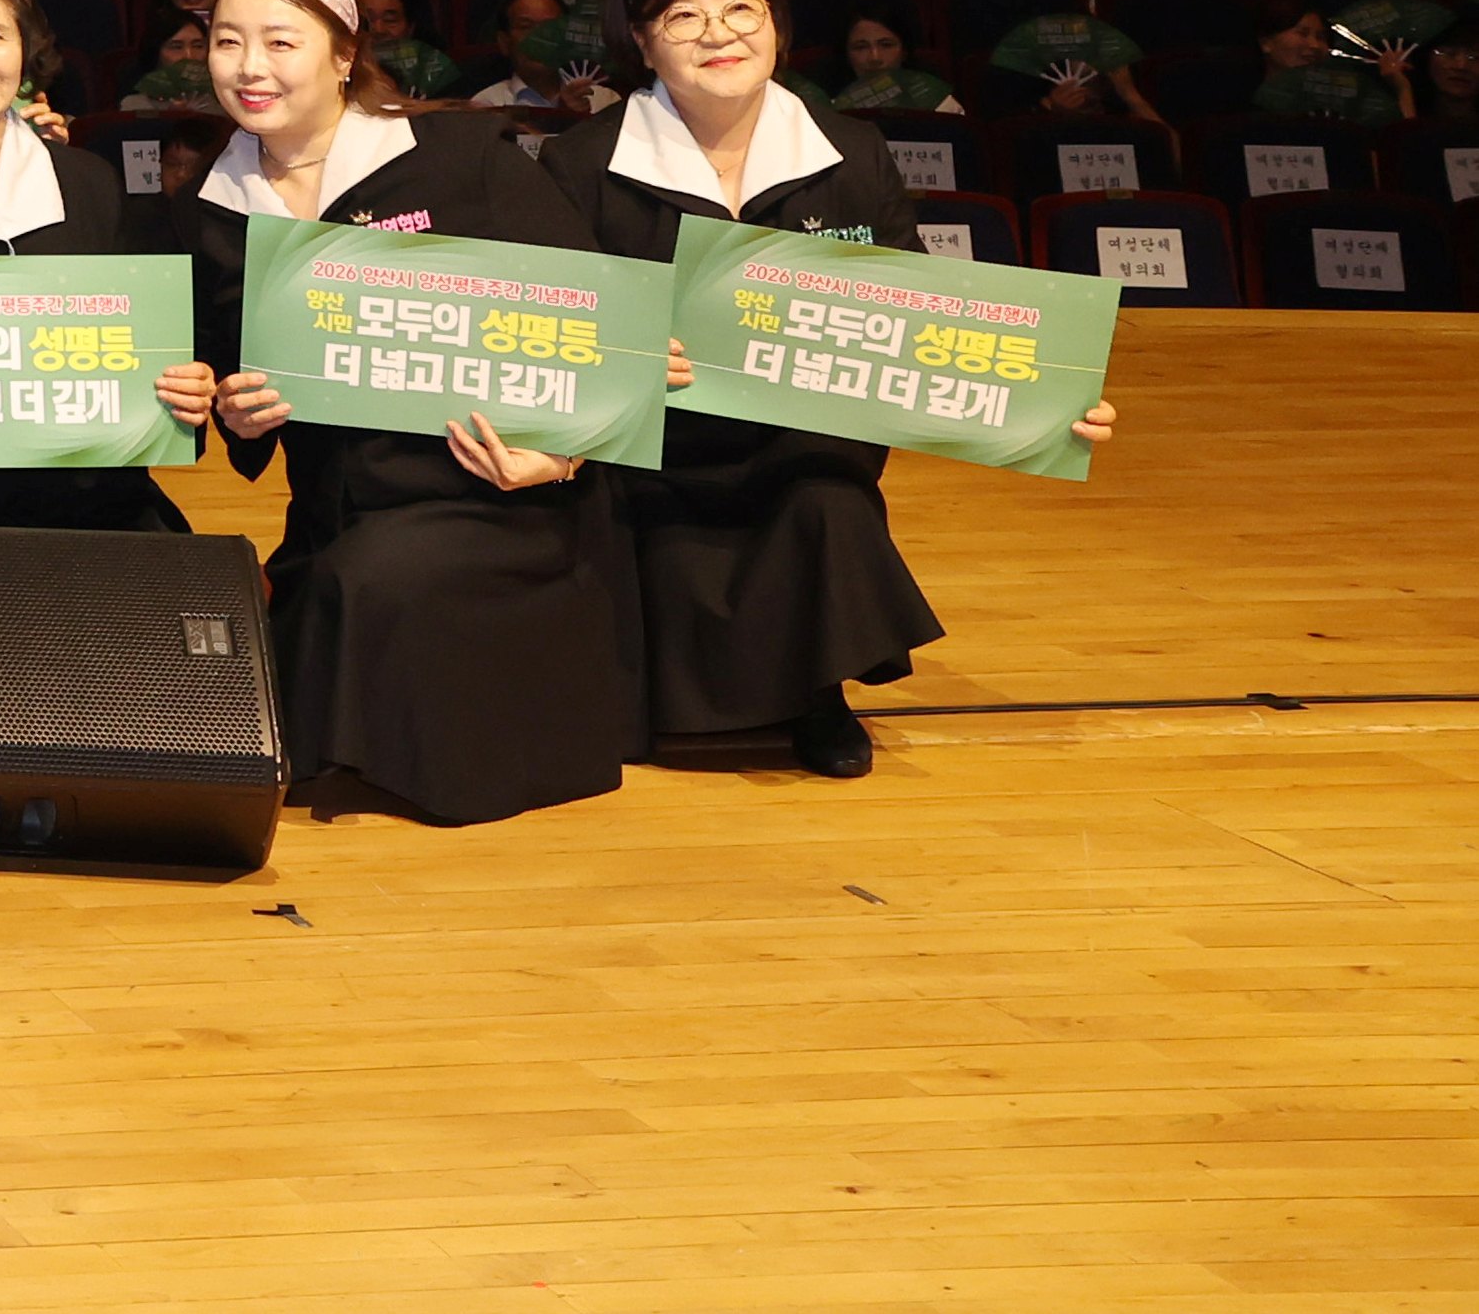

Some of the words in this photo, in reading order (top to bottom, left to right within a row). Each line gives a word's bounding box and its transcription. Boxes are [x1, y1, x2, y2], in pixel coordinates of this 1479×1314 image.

[1107, 236, 1172, 253] 여성단체
[312, 261, 358, 283] 2026
[362, 266, 414, 288] 양산시
[418, 271, 522, 300] 양성평등주간
[527, 284, 597, 309] 기념행사
[1119, 261, 1166, 278] 협의회
[68, 294, 130, 314] 기념행사
[743, 263, 792, 286] 2026
[796, 272, 851, 297] 양산시
[855, 282, 963, 316] 양성평등주간
[967, 301, 1040, 327] 기념행사
[29, 325, 141, 372] 성평등,
[357, 295, 472, 348] 모두의
[479, 310, 604, 365] 성평등,
[783, 299, 907, 358] 모두의
[913, 323, 1041, 382] 성평등,
[9, 380, 45, 424] 더
[51, 380, 121, 425] 깊게
[322, 343, 361, 387] 더
[370, 346, 444, 393] 넓고
[452, 356, 491, 402] 더
[499, 362, 577, 414] 깊게
[740, 339, 786, 384] 더
[790, 348, 873, 399] 넓고
[877, 365, 921, 411] 더
[925, 374, 1011, 429] 깊게
